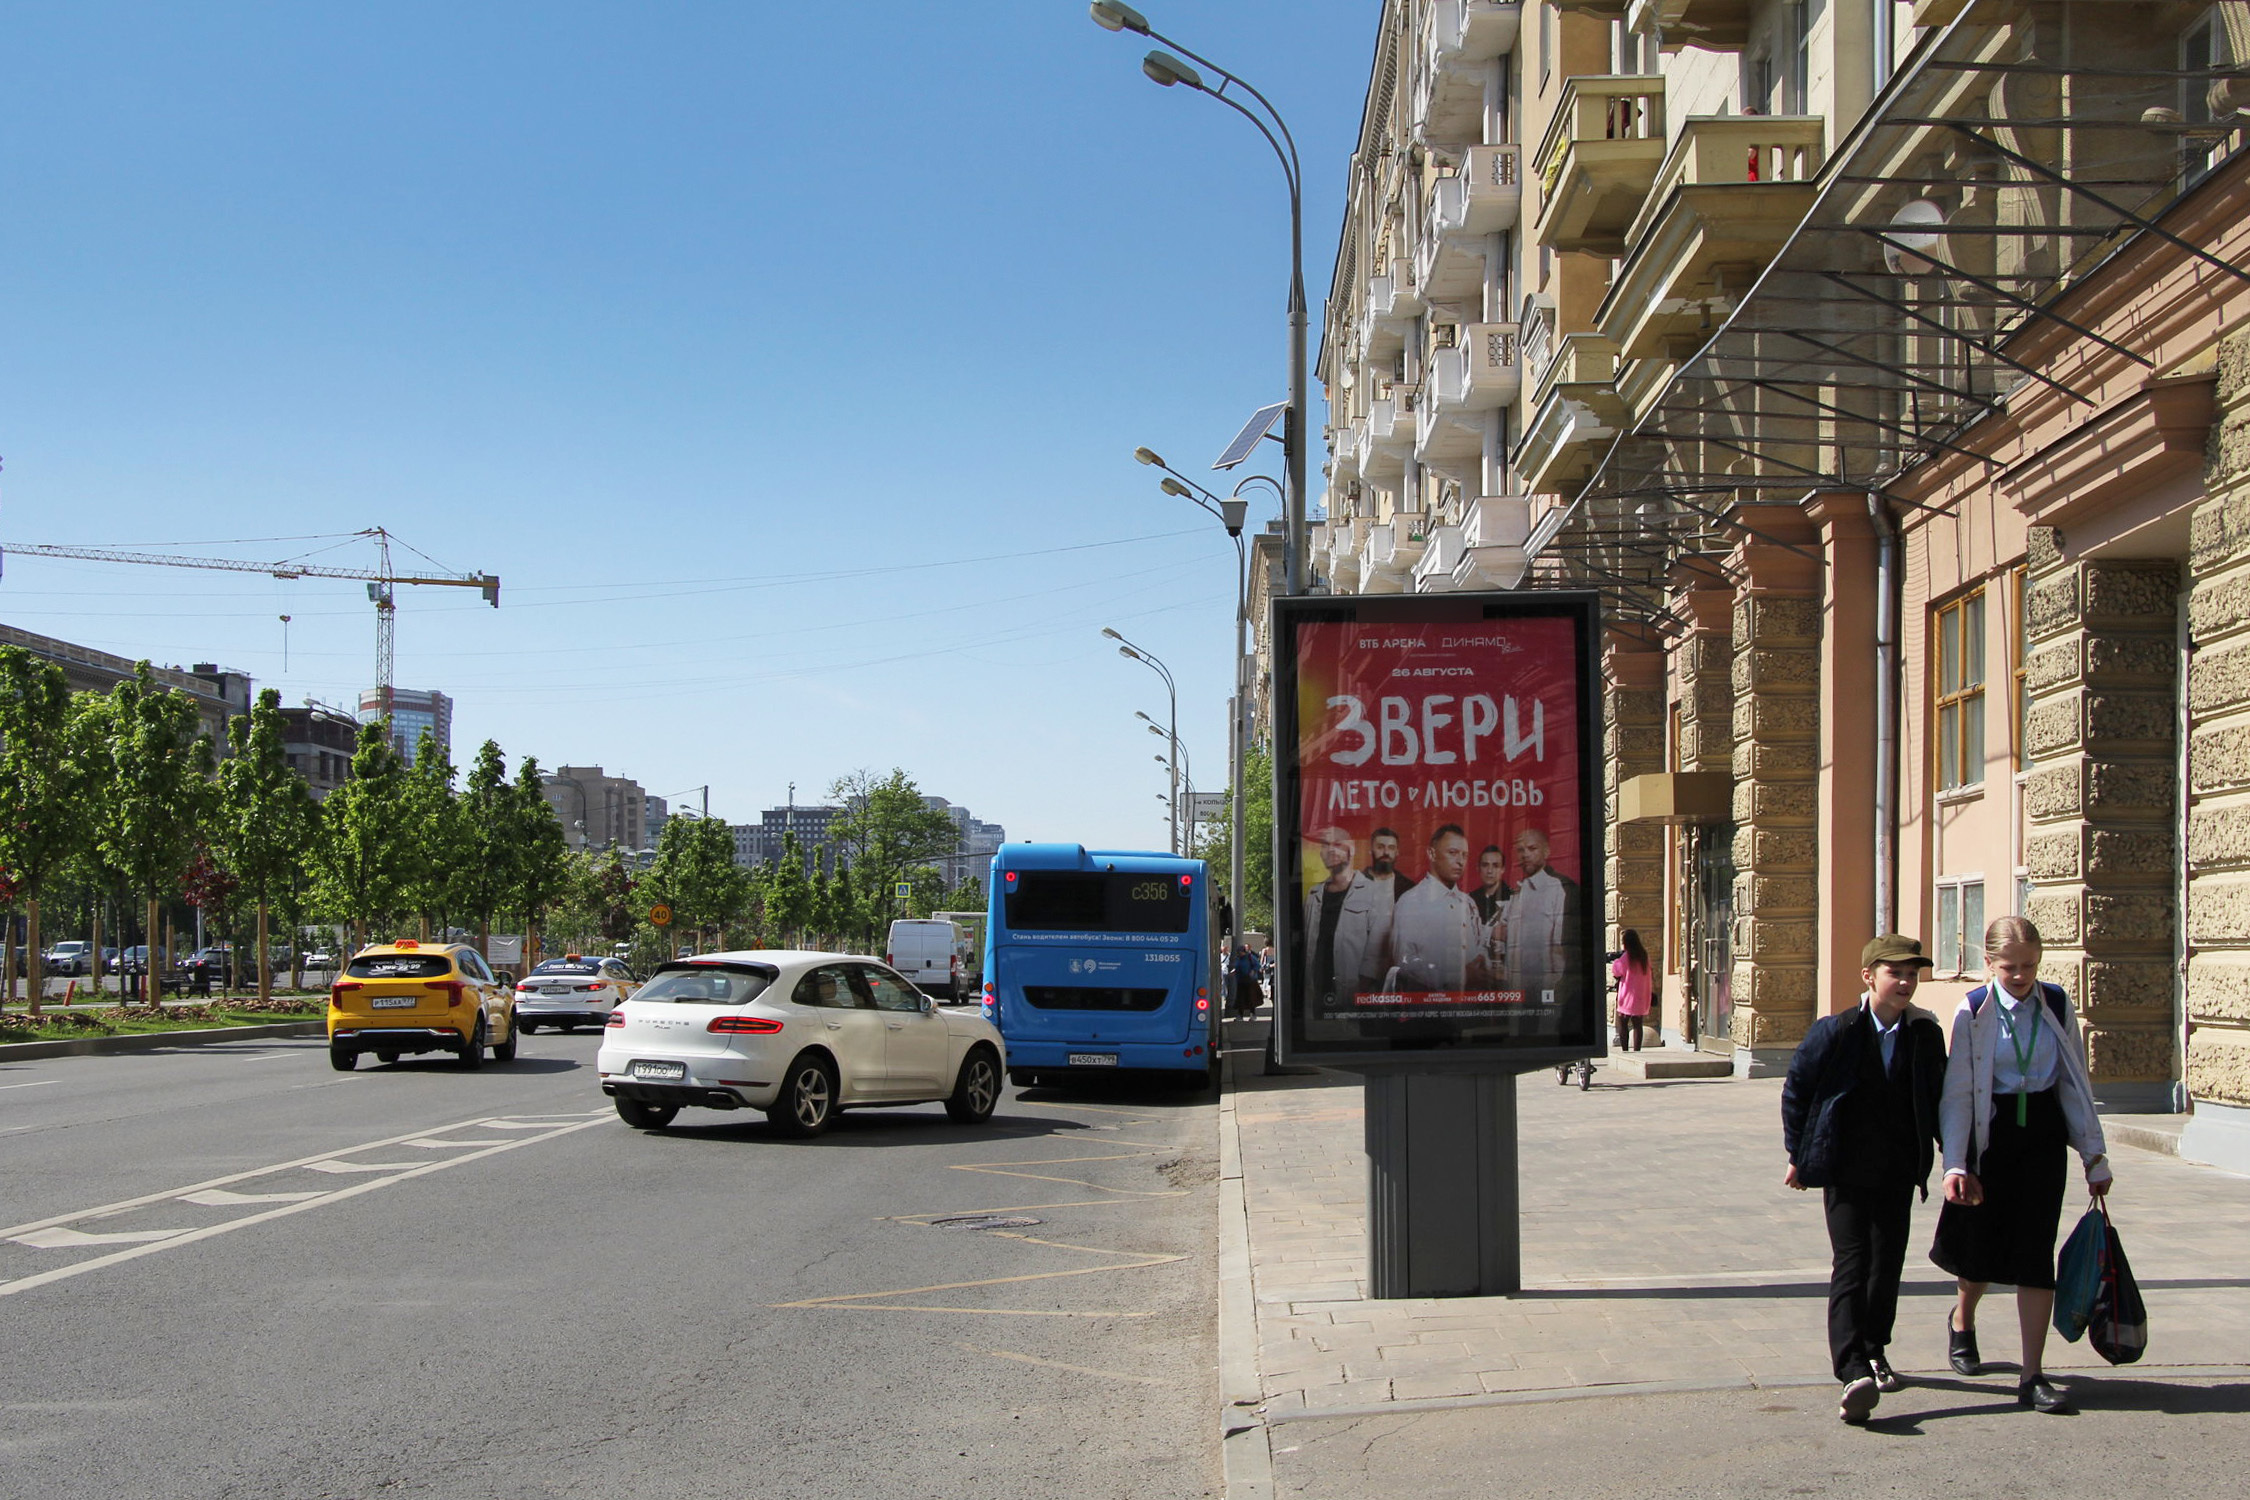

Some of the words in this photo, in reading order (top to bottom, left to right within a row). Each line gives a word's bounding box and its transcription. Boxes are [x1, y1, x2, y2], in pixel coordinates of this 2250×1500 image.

[1359, 639, 1379, 649] ВТБ
[1382, 638, 1427, 649] АРЕНА
[1441, 636, 1506, 648] ДИНАМО
[1413, 667, 1475, 677] АВГУСТА
[1326, 693, 1545, 767] ЗВЕРИ
[1328, 779, 1401, 811] ЛЕТО
[1423, 778, 1545, 809] ЛЮБОВЬ
[654, 910, 667, 920] 40
[1144, 953, 1181, 963] 1318055
[1356, 993, 1412, 1005] redkassa.ru
[1477, 992, 1495, 1002] 665
[1497, 991, 1521, 1002] 9999
